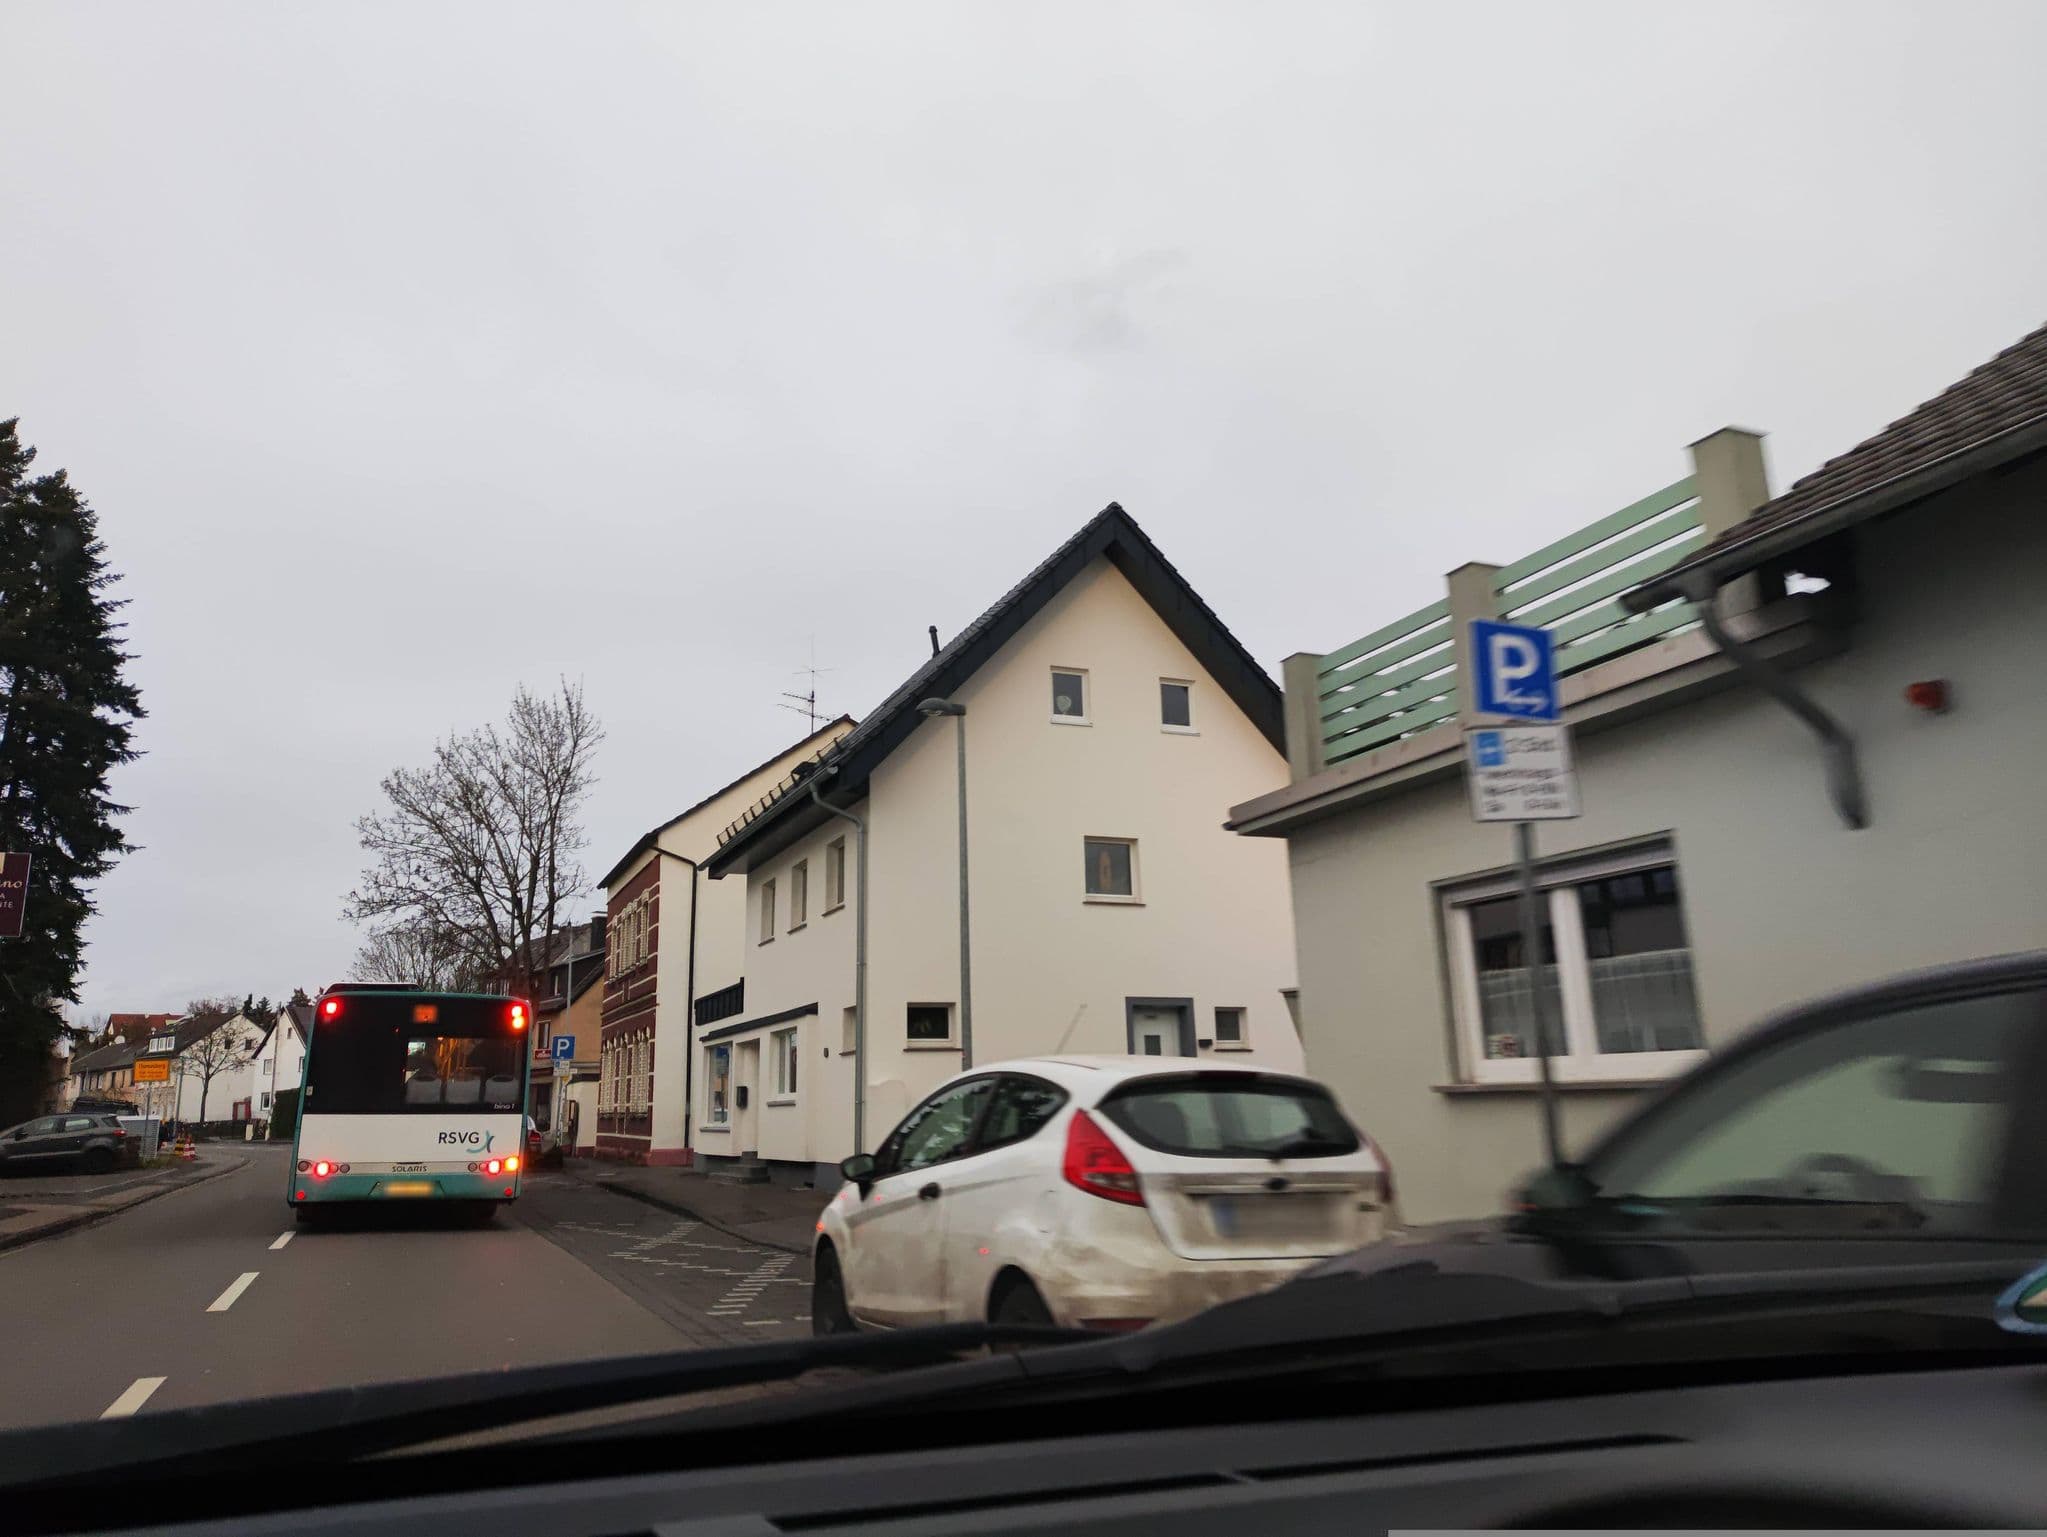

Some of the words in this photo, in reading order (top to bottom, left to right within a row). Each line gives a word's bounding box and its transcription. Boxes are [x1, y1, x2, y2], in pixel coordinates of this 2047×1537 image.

[1488, 633, 1540, 704] P
[556, 1038, 570, 1057] P
[438, 1131, 480, 1144] RSVG
[392, 1165, 428, 1173] SOLARIS
